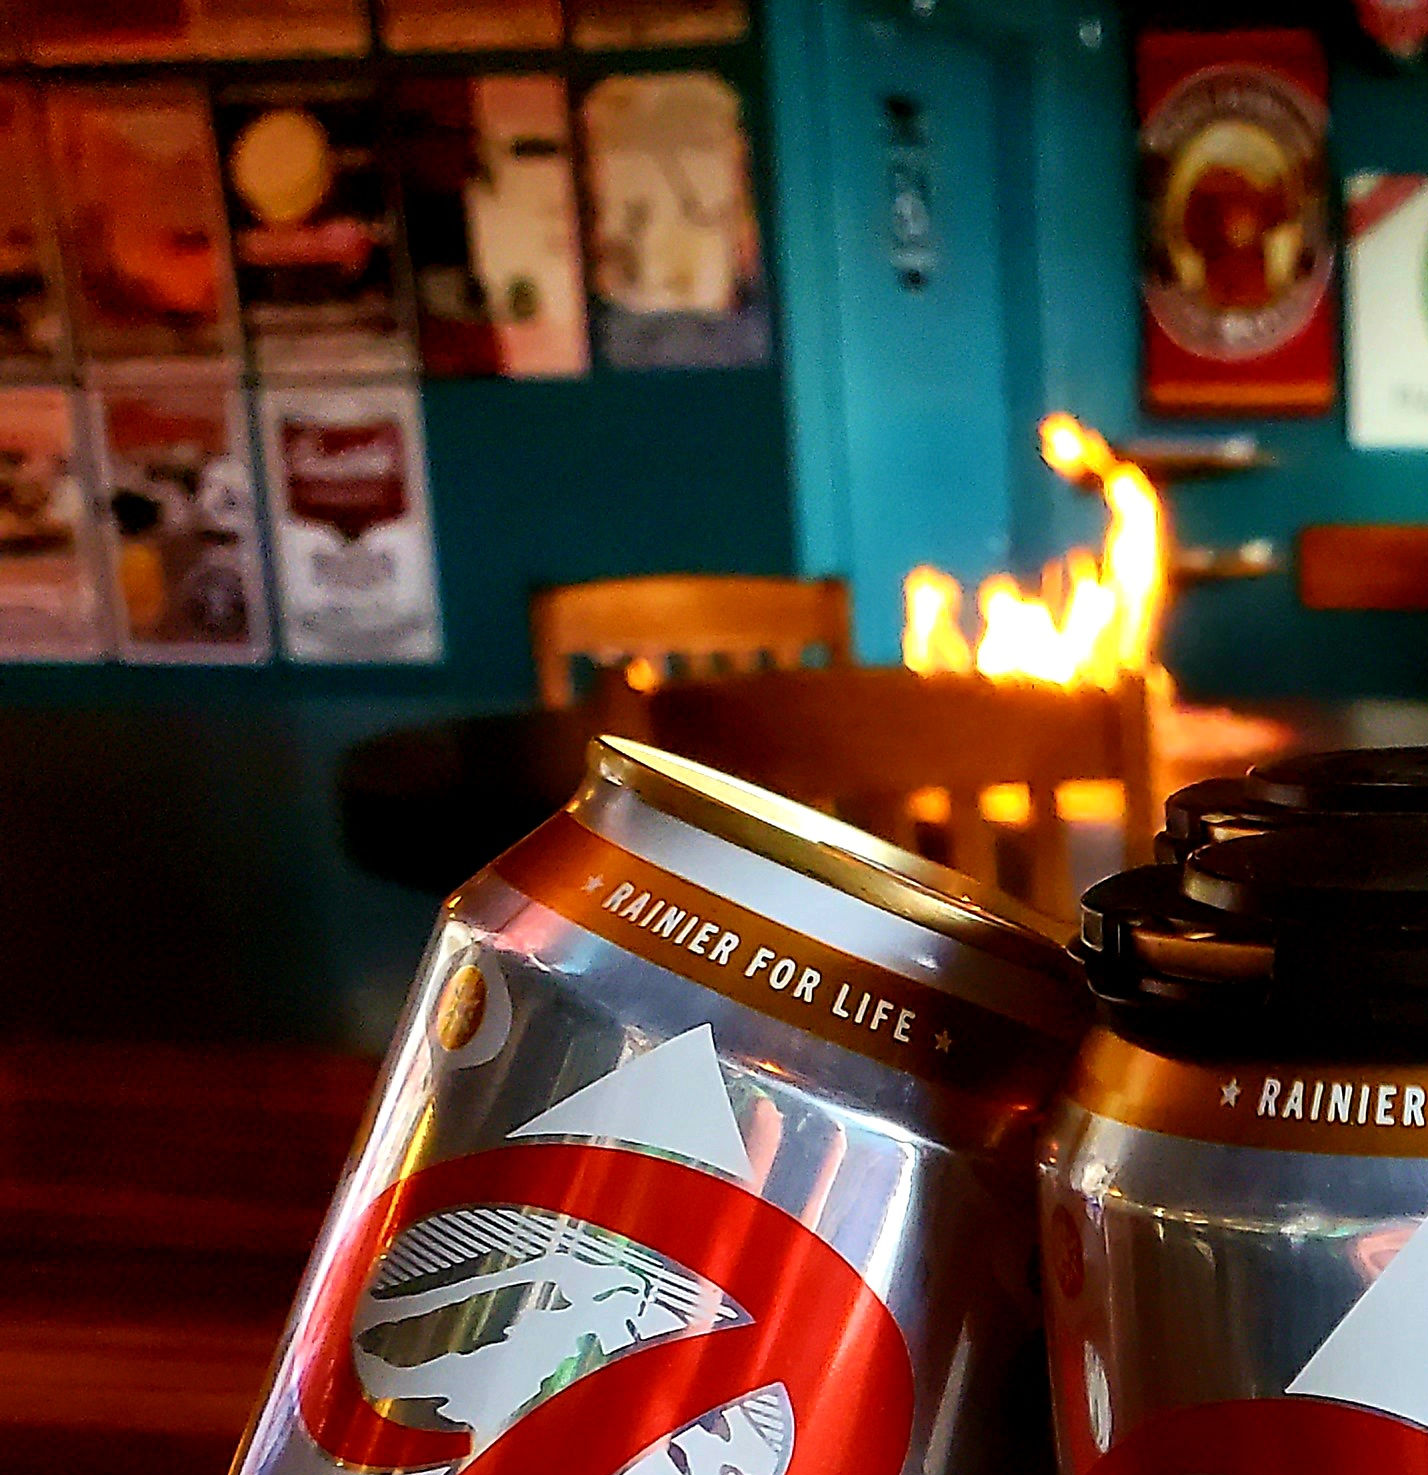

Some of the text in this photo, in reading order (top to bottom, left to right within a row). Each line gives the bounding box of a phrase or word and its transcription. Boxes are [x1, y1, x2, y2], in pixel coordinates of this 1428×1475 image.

[602, 881, 917, 1043] RAINIER FOR LIFE
[1256, 1077, 1427, 1128] RAINIER
